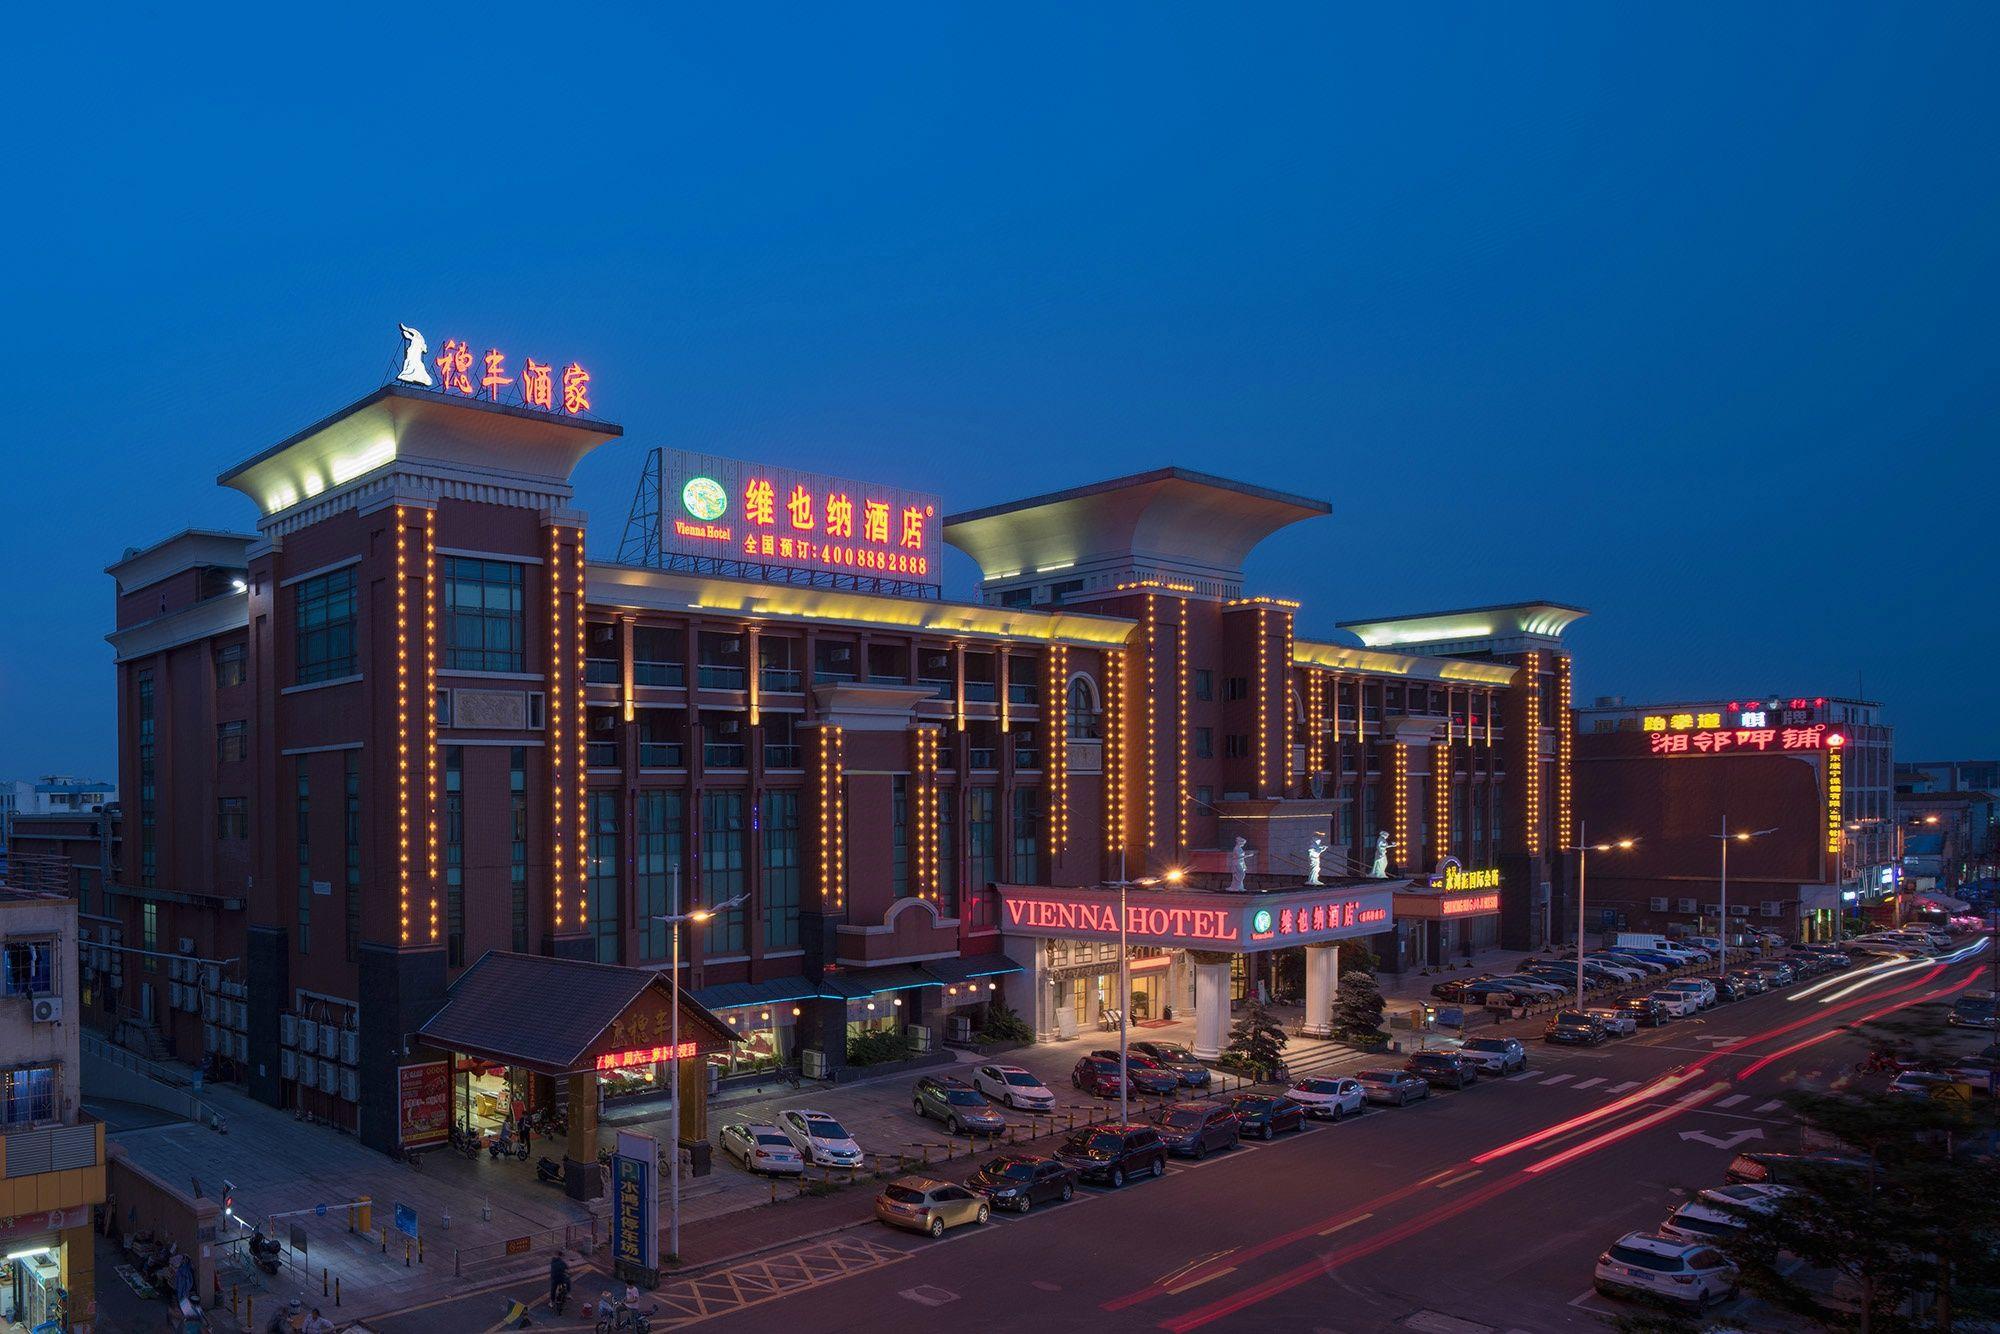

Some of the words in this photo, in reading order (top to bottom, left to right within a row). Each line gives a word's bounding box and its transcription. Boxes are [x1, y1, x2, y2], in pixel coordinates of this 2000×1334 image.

[745, 479, 923, 549] 维也纳酒店
[675, 521, 706, 538] Vienna
[706, 525, 730, 541] Hotel
[1651, 723, 1826, 753] 湘邻呷铺
[1006, 899, 1120, 933] VIENNA
[1126, 906, 1237, 940] HOTEL
[1280, 902, 1355, 934] 维也纳酒店
